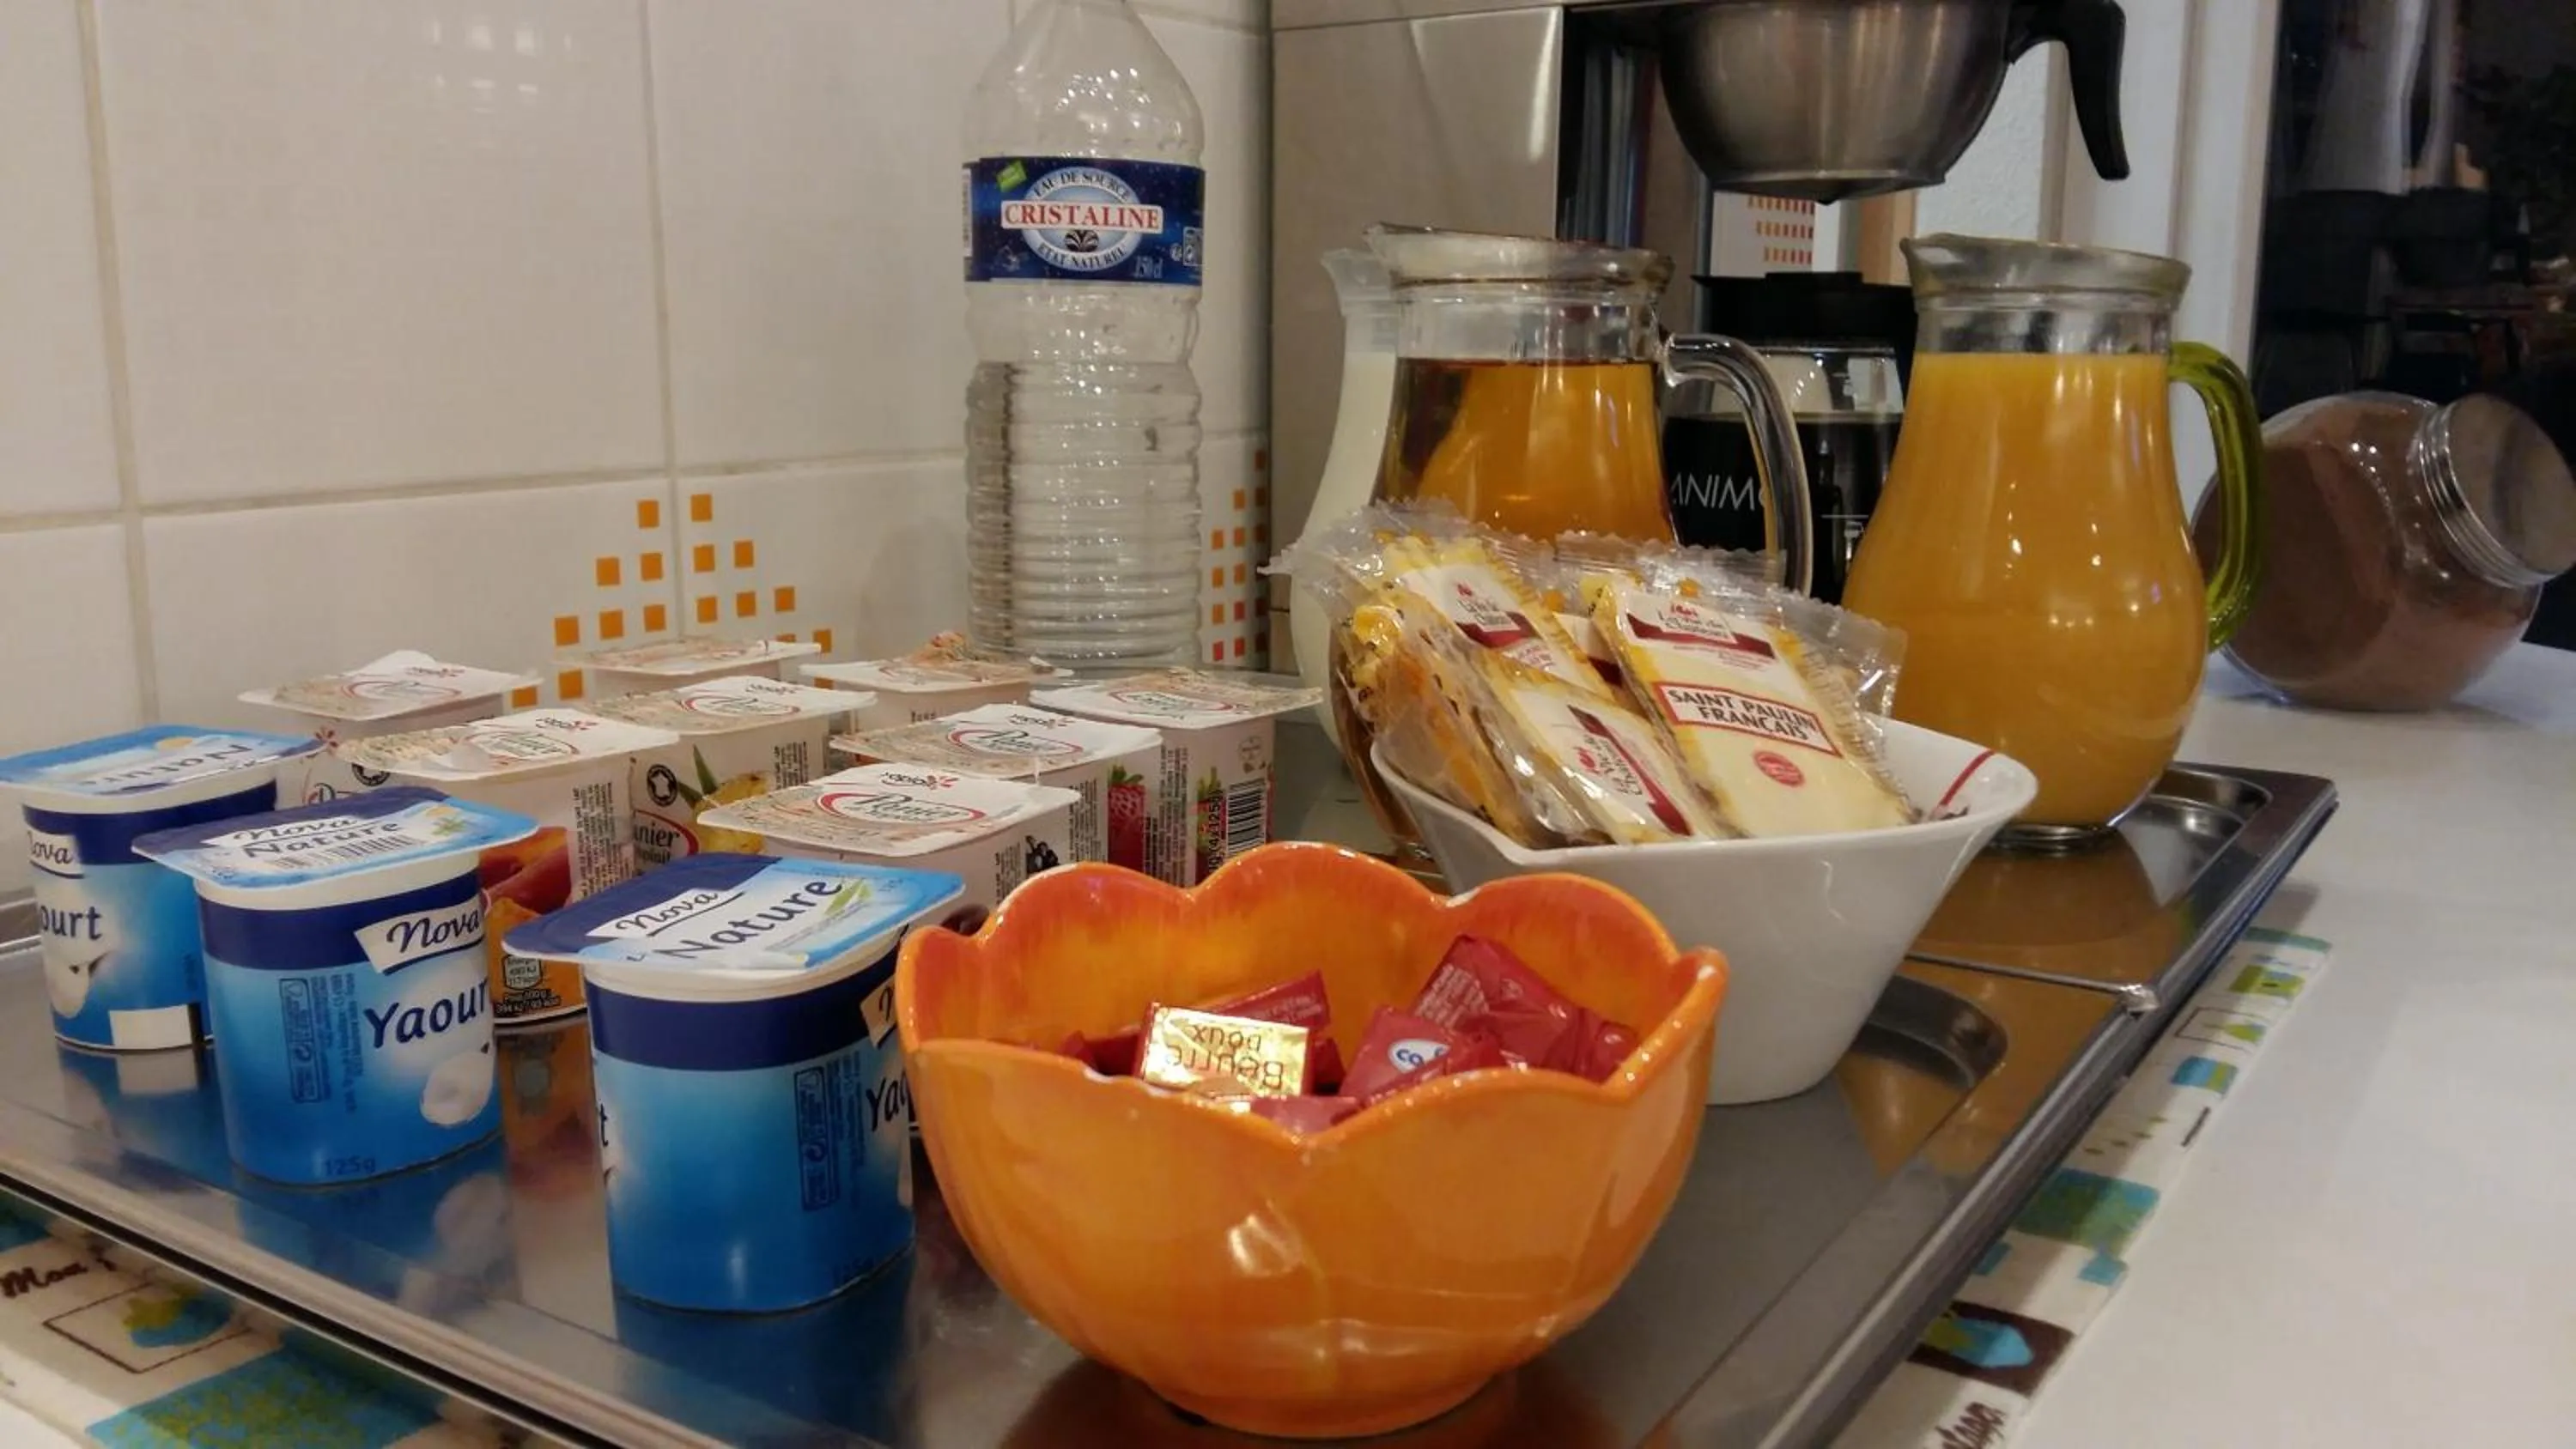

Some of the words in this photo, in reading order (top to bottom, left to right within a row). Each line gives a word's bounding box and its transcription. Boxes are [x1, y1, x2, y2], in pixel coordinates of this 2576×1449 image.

[1033, 175, 1055, 197] EAU
[1060, 173, 1078, 183] DE
[1082, 173, 1132, 202] SOURCE
[1005, 204, 1159, 229] CRISTALINE
[1072, 247, 1127, 269] NATUREL
[1672, 472, 1763, 512] ANIM
[1668, 689, 1733, 712] SAINT
[1743, 700, 1818, 731] PAULIN
[233, 817, 359, 841] Nova
[242, 822, 401, 858] Nature
[615, 891, 720, 930] Nova
[652, 881, 843, 959] Nature
[386, 909, 480, 954] Nova
[325, 1155, 376, 1176] 125g
